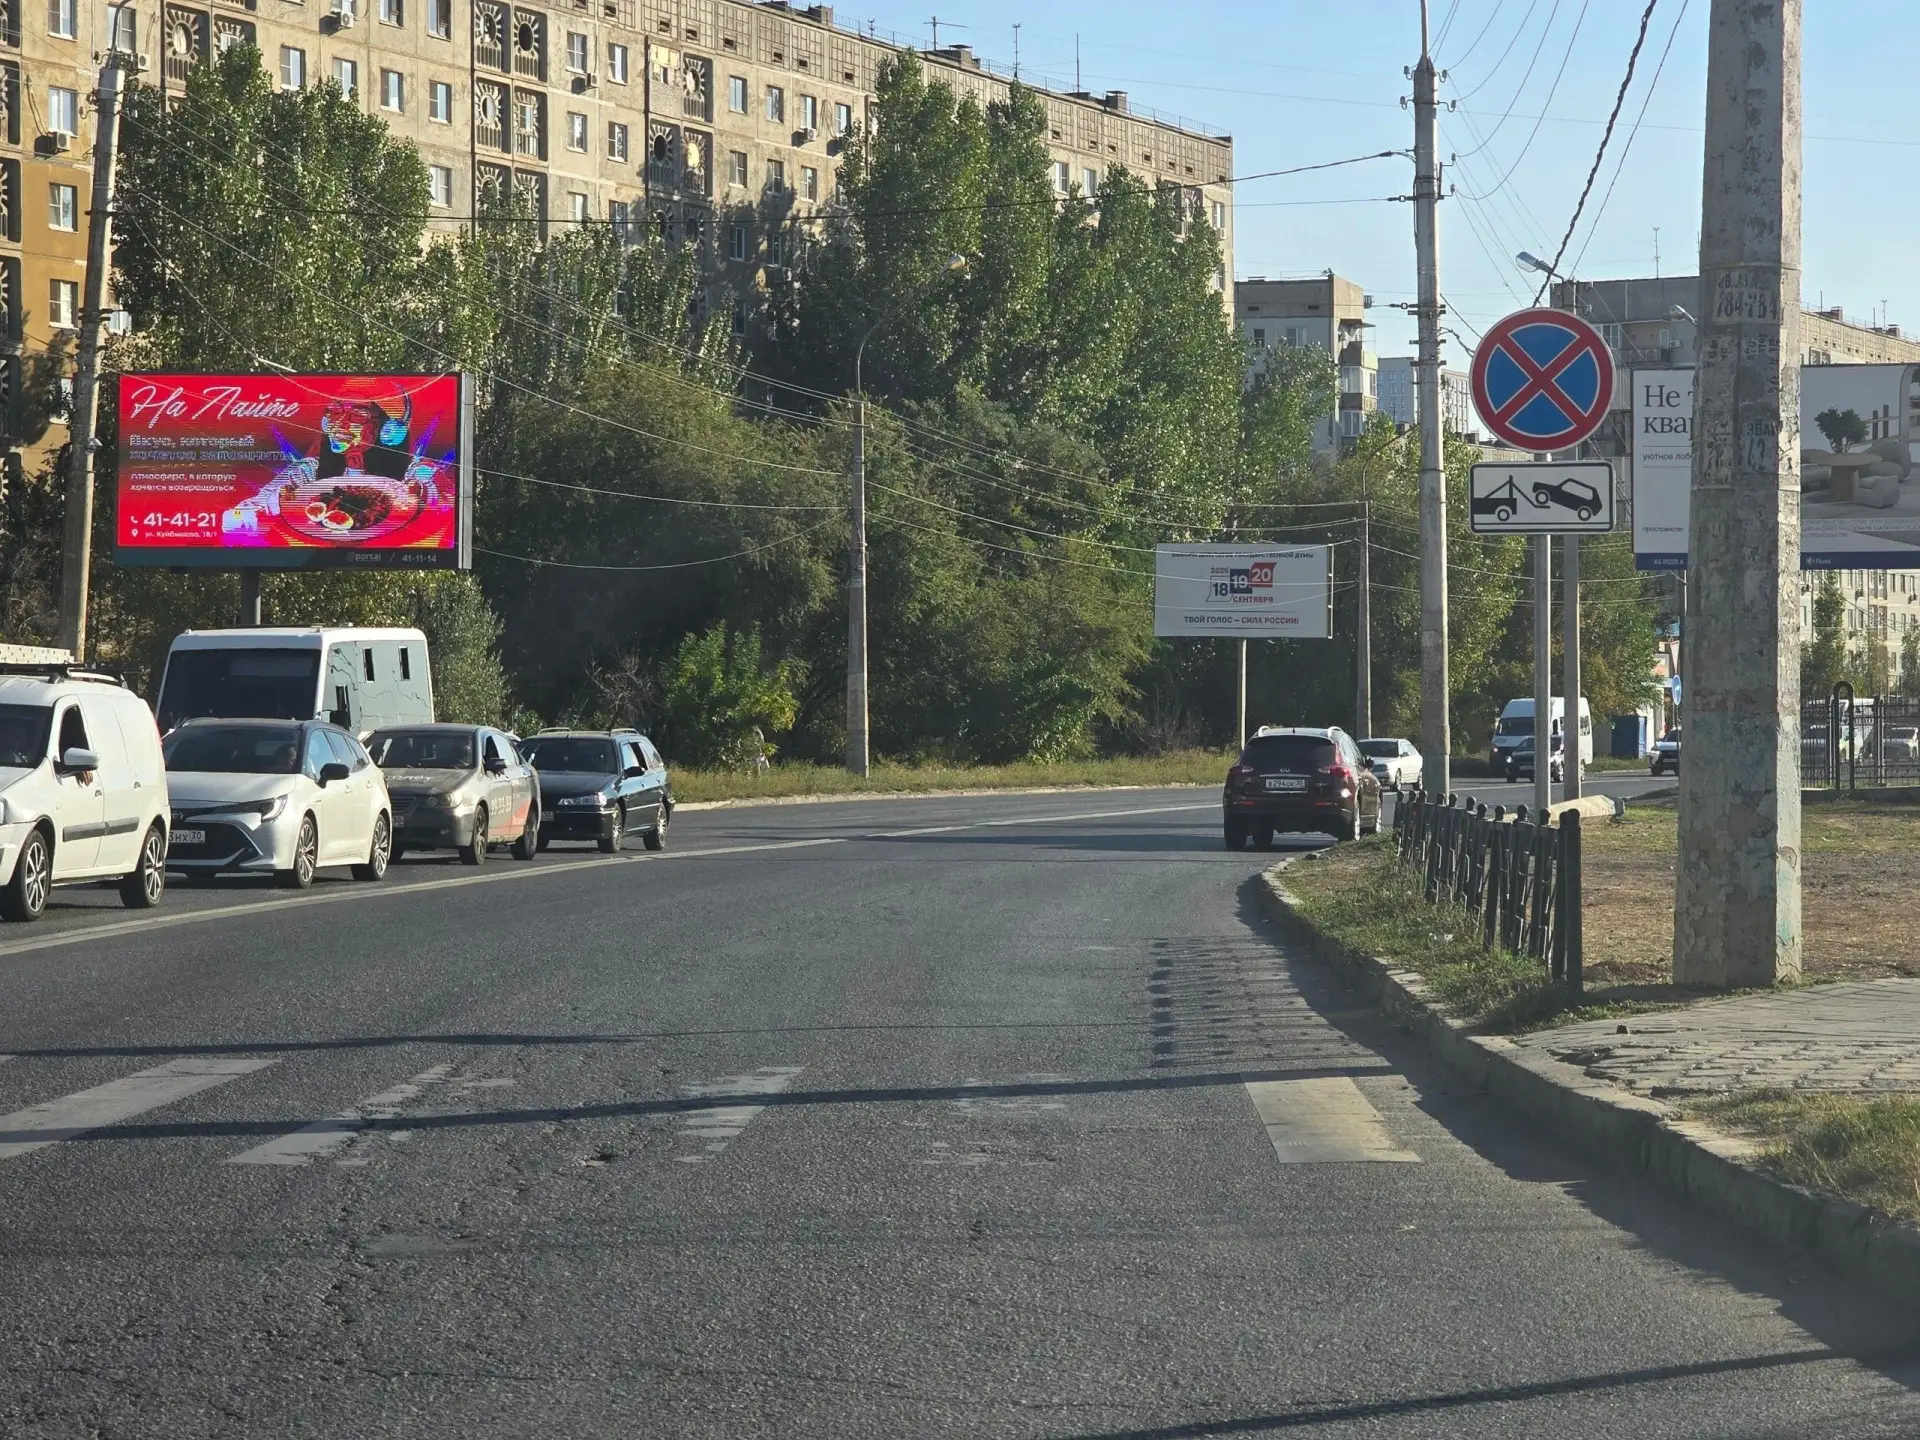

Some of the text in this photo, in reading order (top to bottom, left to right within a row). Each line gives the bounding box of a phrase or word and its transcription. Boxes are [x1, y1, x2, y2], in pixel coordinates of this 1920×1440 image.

[1644, 385, 1680, 408] Не
[131, 386, 300, 428] На Лайте
[1642, 452, 1693, 462] уютное лоб
[143, 512, 216, 527] 41-41-21
[402, 554, 437, 563] 41-11-14
[1295, 552, 1314, 560] ДУМЫ
[1212, 568, 1272, 597] 18 19 20
[1233, 596, 1274, 604] СЕНТЯБРЯ
[1184, 615, 1206, 624] ТВОЙ
[1206, 616, 1233, 624] ГОЛОС
[1241, 616, 1263, 625] СИЛА
[191, 831, 202, 840] 30
